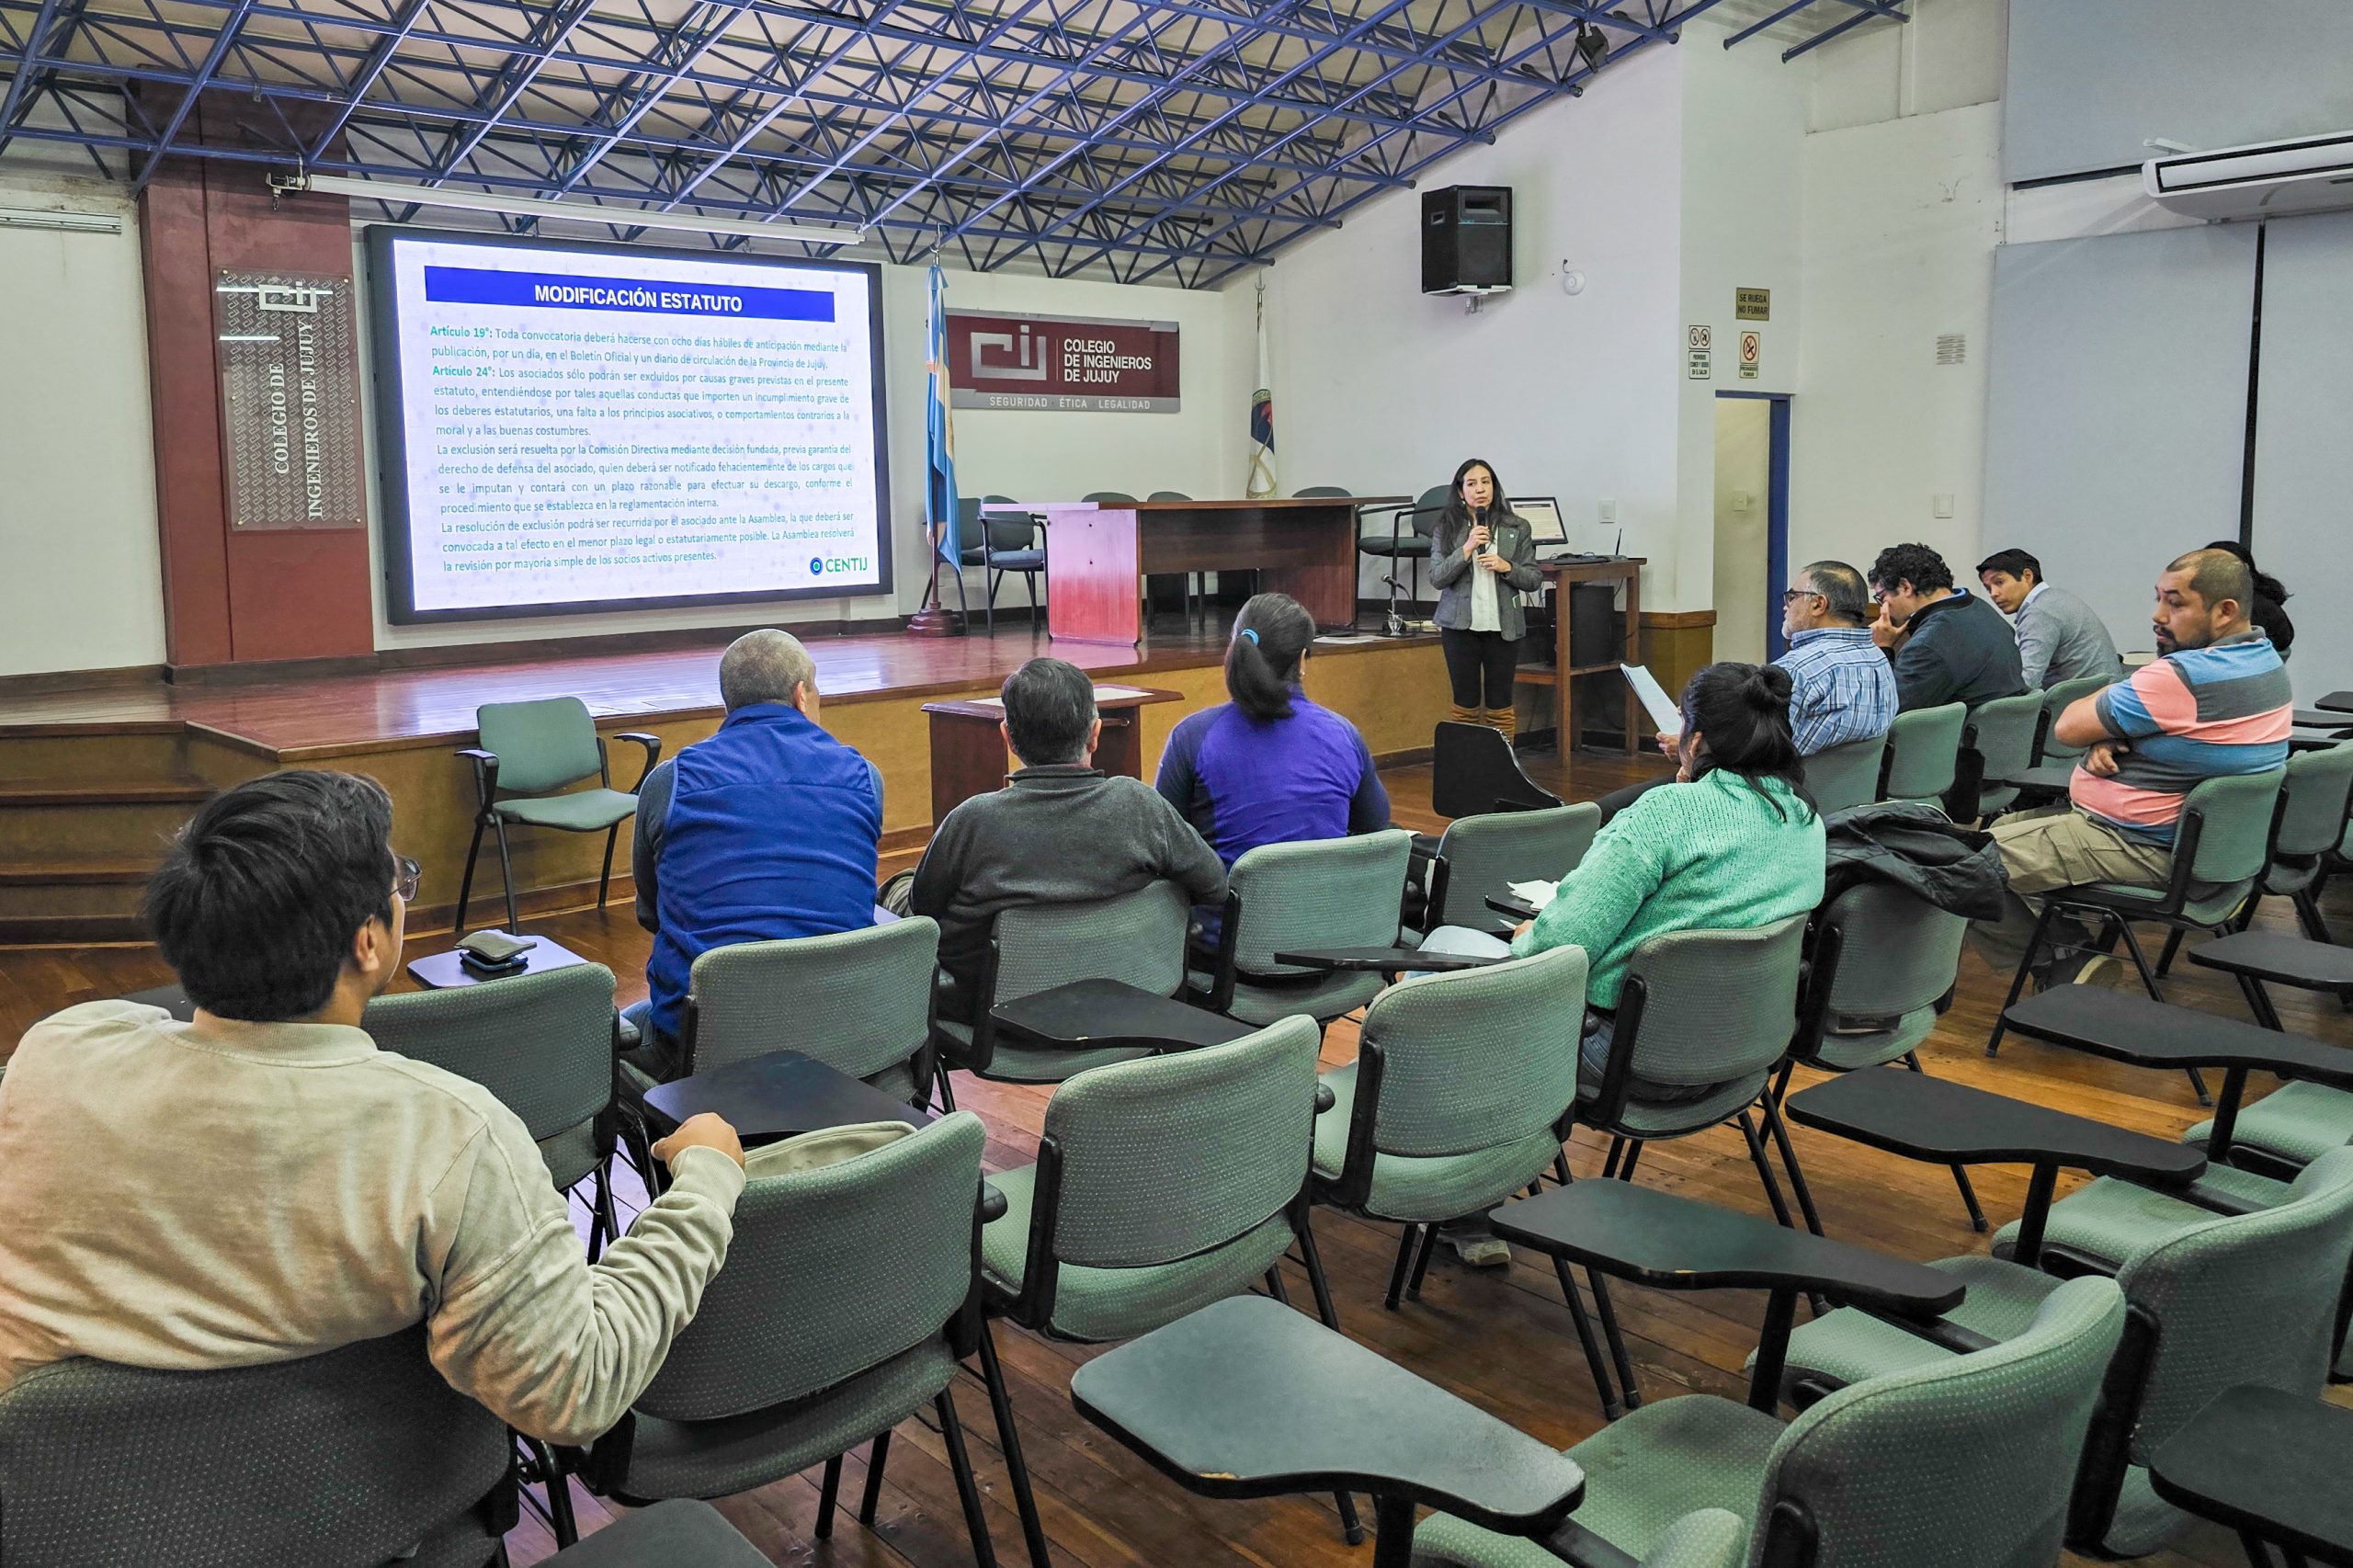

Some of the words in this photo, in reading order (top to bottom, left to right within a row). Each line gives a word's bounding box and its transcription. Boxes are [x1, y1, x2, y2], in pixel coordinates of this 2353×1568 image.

[535, 284, 657, 308] MODIFICACIÓN
[661, 292, 743, 312] ESTATUTO
[1739, 294, 1747, 302] SE
[1747, 294, 1767, 303] RUEGA
[1747, 306, 1768, 315] FUMAR
[298, 320, 315, 376] JUJUY
[429, 325, 471, 337] Artículo
[494, 328, 518, 339] Toda
[521, 329, 581, 342] convocatoria
[584, 332, 615, 343] deberá
[617, 333, 651, 345] hacerse
[654, 337, 668, 346] con
[671, 335, 691, 347] ocho
[694, 336, 710, 347] días
[712, 337, 741, 348] hábiles
[755, 339, 801, 353] anticipación
[803, 341, 838, 352] mediante
[1063, 338, 1116, 354] COLEGIO
[431, 345, 489, 360] publicación,
[493, 350, 508, 361] por
[604, 351, 631, 362] Oficial
[692, 354, 735, 366] circulación
[1063, 354, 1080, 368] DE
[1083, 355, 1153, 370] INGENIEROS
[269, 363, 284, 388] DE
[432, 365, 472, 377] Artículo
[499, 367, 514, 378] Los
[517, 367, 563, 379] asociados
[566, 369, 585, 380] sólo
[588, 369, 620, 382] podrán
[640, 370, 678, 381] excluidos
[682, 374, 696, 384] por
[699, 375, 726, 383] causas
[729, 376, 755, 386] graves
[757, 374, 791, 387] previstas
[816, 375, 847, 388] presente
[1063, 369, 1081, 382] DE
[1083, 370, 1120, 383] JUJUY
[301, 380, 317, 403] DE
[433, 384, 477, 398] estatuto,
[481, 385, 551, 398] entendiéndose
[555, 390, 571, 401] por
[574, 387, 596, 398] tales
[597, 388, 635, 402] aquellas
[637, 389, 680, 400] conductas
[683, 392, 699, 403] que
[701, 390, 739, 403] importen
[817, 395, 837, 404] grave
[435, 404, 449, 415] los
[452, 404, 491, 415] deberes
[494, 405, 552, 418] estatutarios,
[576, 406, 596, 417] falta
[608, 406, 620, 417] los
[622, 407, 665, 420] principios
[666, 407, 714, 420] asociativos,
[724, 408, 794, 421] comportamientos
[796, 409, 834, 419] contrarios
[989, 396, 1048, 408] SEGURIDAD
[1059, 396, 1087, 409] ÉTICA
[1098, 399, 1150, 410] LEGALIDAD
[271, 392, 290, 474] COLEGIO
[436, 424, 464, 435] moral
[483, 425, 496, 435] las
[499, 425, 532, 436] buenas
[535, 425, 590, 436] costumbres.
[450, 444, 494, 455] exclusión
[497, 444, 517, 454] será
[520, 444, 557, 454] resuelta
[560, 447, 575, 457] por
[588, 444, 629, 454] Comisión
[631, 444, 668, 454] Directiva
[670, 444, 710, 454] mediante
[711, 444, 745, 453] decisión
[746, 444, 780, 455] fundada,
[782, 444, 805, 456] previa
[839, 444, 850, 453] del
[303, 407, 323, 518] INGENIEROS
[438, 463, 478, 474] derecho
[496, 462, 533, 473] defensa
[536, 462, 551, 473] del
[553, 462, 596, 474] asociado,
[598, 462, 623, 475] quien
[626, 461, 656, 472] deberá
[674, 461, 716, 472] notificado
[718, 460, 784, 472] fehacientemente
[799, 460, 809, 471] los
[812, 463, 835, 472] cargos
[837, 462, 852, 472] que
[472, 482, 512, 496] imputan
[530, 481, 565, 493] contará
[572, 483, 587, 492] con
[611, 480, 634, 494] plazo
[640, 480, 681, 490] razonable
[688, 482, 705, 492] para
[710, 479, 744, 489] efectuar
[764, 478, 799, 491] descargo,
[805, 477, 840, 487] conforme
[440, 501, 511, 517] procedimiento
[513, 504, 531, 514] que
[546, 499, 593, 511] establezca
[619, 497, 684, 511] reglamentación
[687, 496, 718, 507] interna.
[455, 520, 505, 532] resolución
[522, 518, 564, 530] exclusión
[567, 517, 593, 531] podrá
[596, 520, 609, 528] ser
[612, 517, 652, 528] recurrida
[654, 518, 668, 528] por
[680, 515, 716, 526] asociado
[719, 514, 736, 524] ante
[747, 512, 787, 525] Asamblea,
[800, 514, 813, 524] que
[815, 511, 840, 521] deberá
[442, 540, 494, 552] convocada
[505, 539, 517, 551] tal
[520, 538, 550, 550] efecto
[578, 539, 608, 547] menor
[609, 535, 632, 549] plazo
[635, 534, 654, 548] legal
[665, 531, 736, 544] estatutariamente
[782, 528, 818, 540] Asamblea
[820, 527, 854, 538] resolverá
[454, 559, 492, 572] revisión
[494, 561, 512, 573] por
[553, 555, 584, 570] simple
[598, 554, 611, 565] los
[613, 552, 640, 564] socios
[642, 551, 672, 562] activos
[674, 550, 716, 563] presentes.
